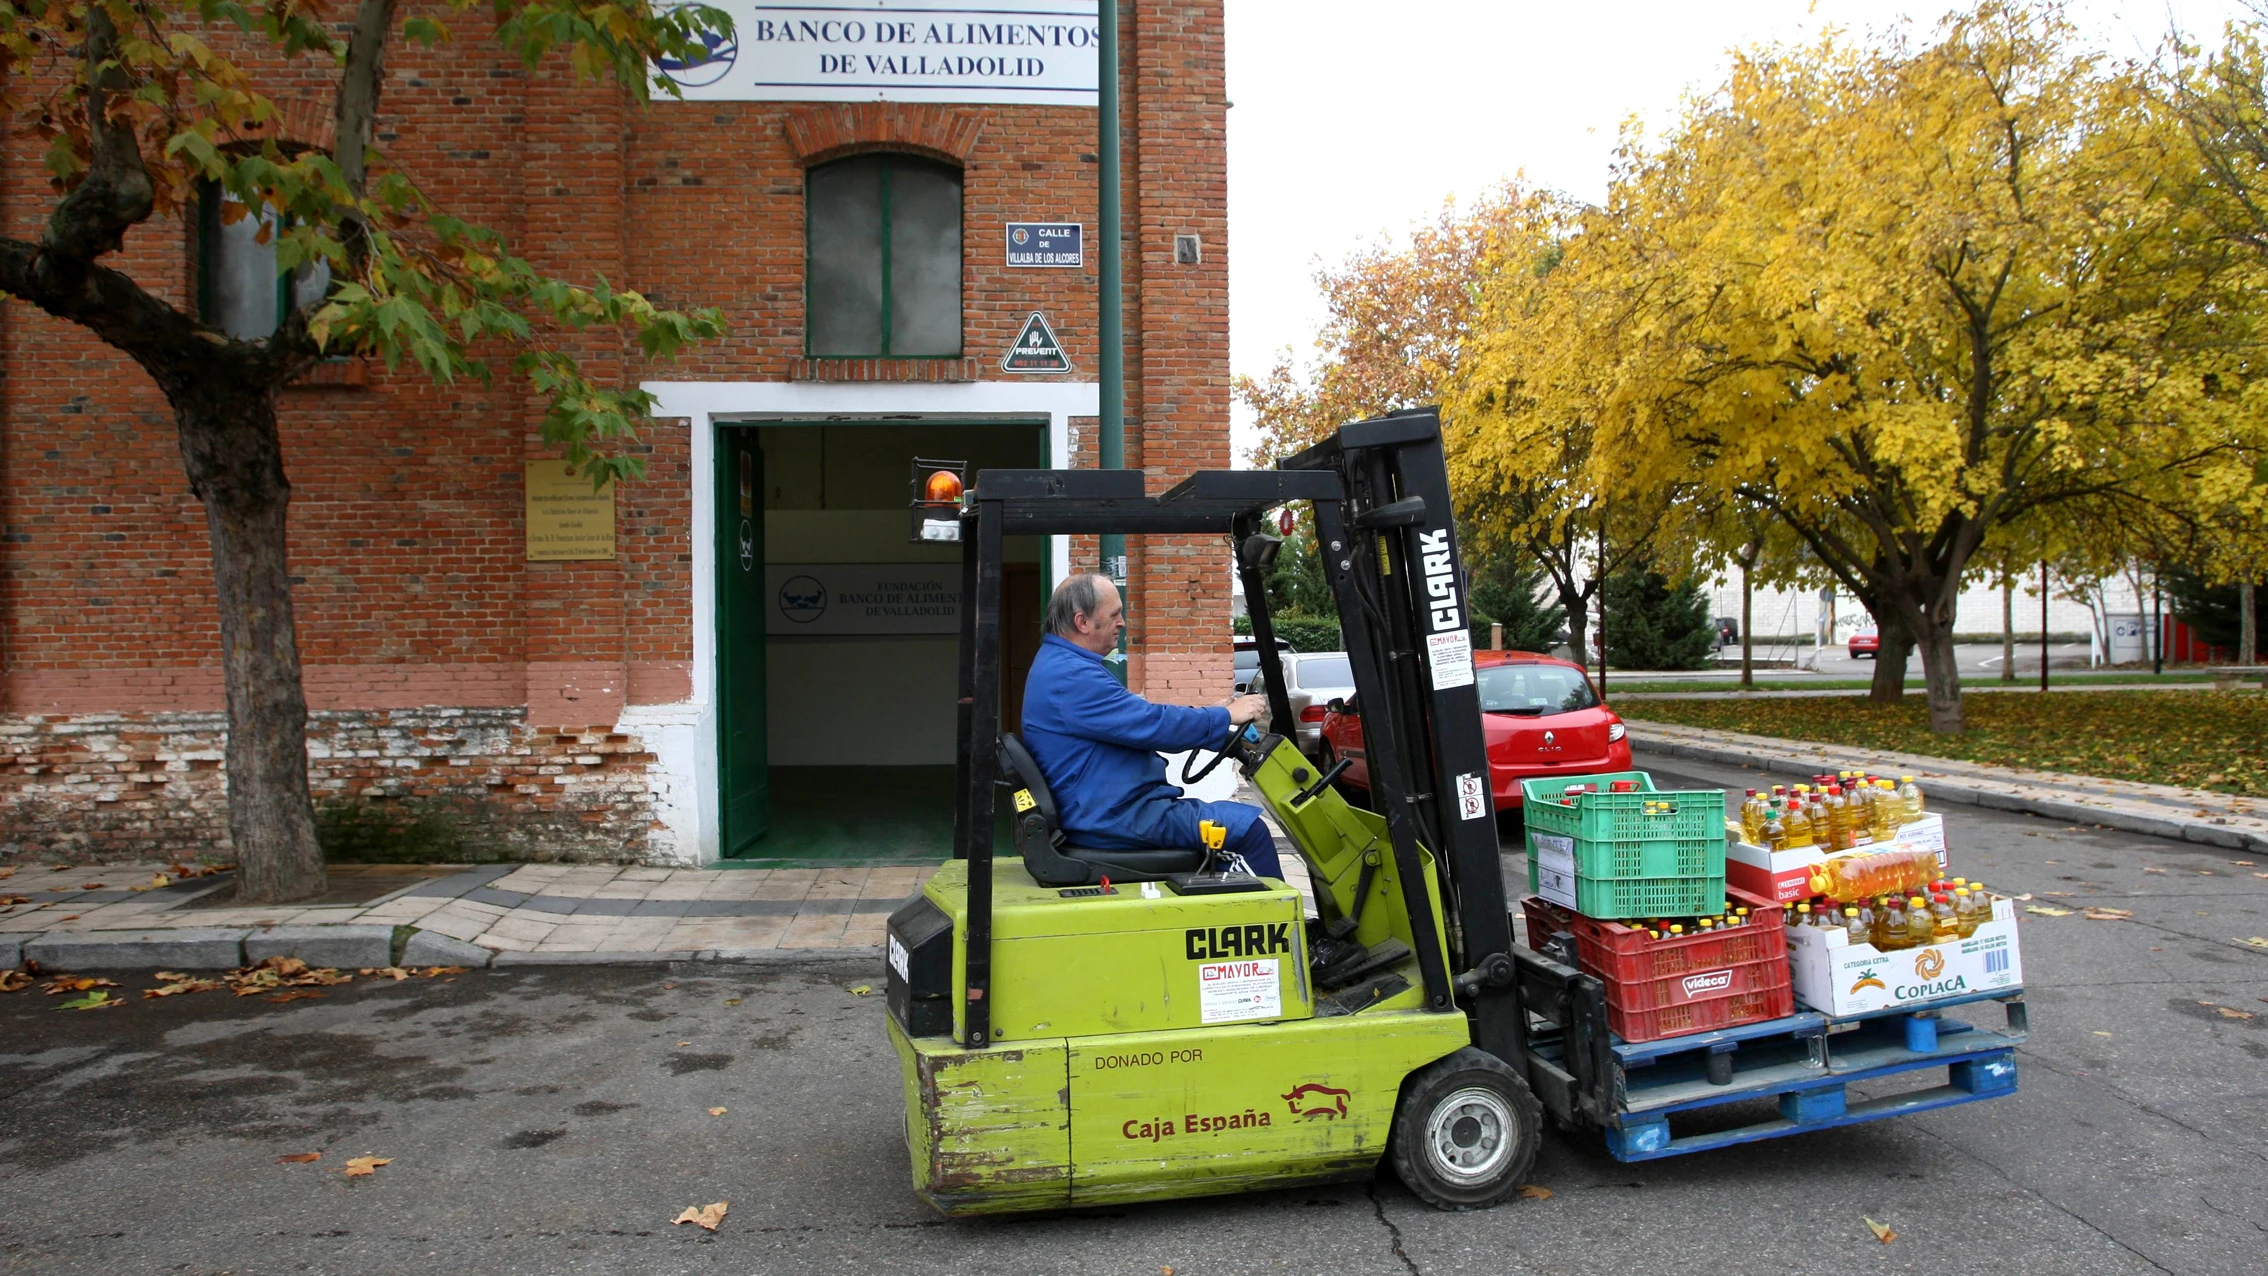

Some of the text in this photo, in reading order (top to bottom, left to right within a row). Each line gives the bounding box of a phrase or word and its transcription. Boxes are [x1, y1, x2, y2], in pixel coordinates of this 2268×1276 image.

[755, 20, 1099, 48] BANCO DE ALIMENTOS
[819, 54, 1044, 77] DE VALLADOLID
[1038, 229, 1071, 237] CALLE
[1009, 252, 1080, 264] VILLALBA DE LOS ALCORES
[1015, 347, 1058, 356] PREVENT
[877, 580, 943, 592] FUNDACIÓN
[1419, 528, 1461, 631] CLARK
[840, 593, 884, 604] BANCO
[886, 593, 903, 604] DE
[865, 607, 955, 616] DE VALLADOLID
[1778, 888, 1800, 899] basic
[1185, 923, 1290, 960] CLARK
[889, 933, 909, 984] CLARK
[1843, 956, 1889, 969] CATEGORIA EXTRA
[1218, 963, 1259, 979] MAYOR
[1686, 976, 1728, 989] videca
[1894, 974, 1966, 1000] COPLACA
[1095, 1049, 1203, 1069] DONADO POR
[1122, 1108, 1272, 1143] Caja España
